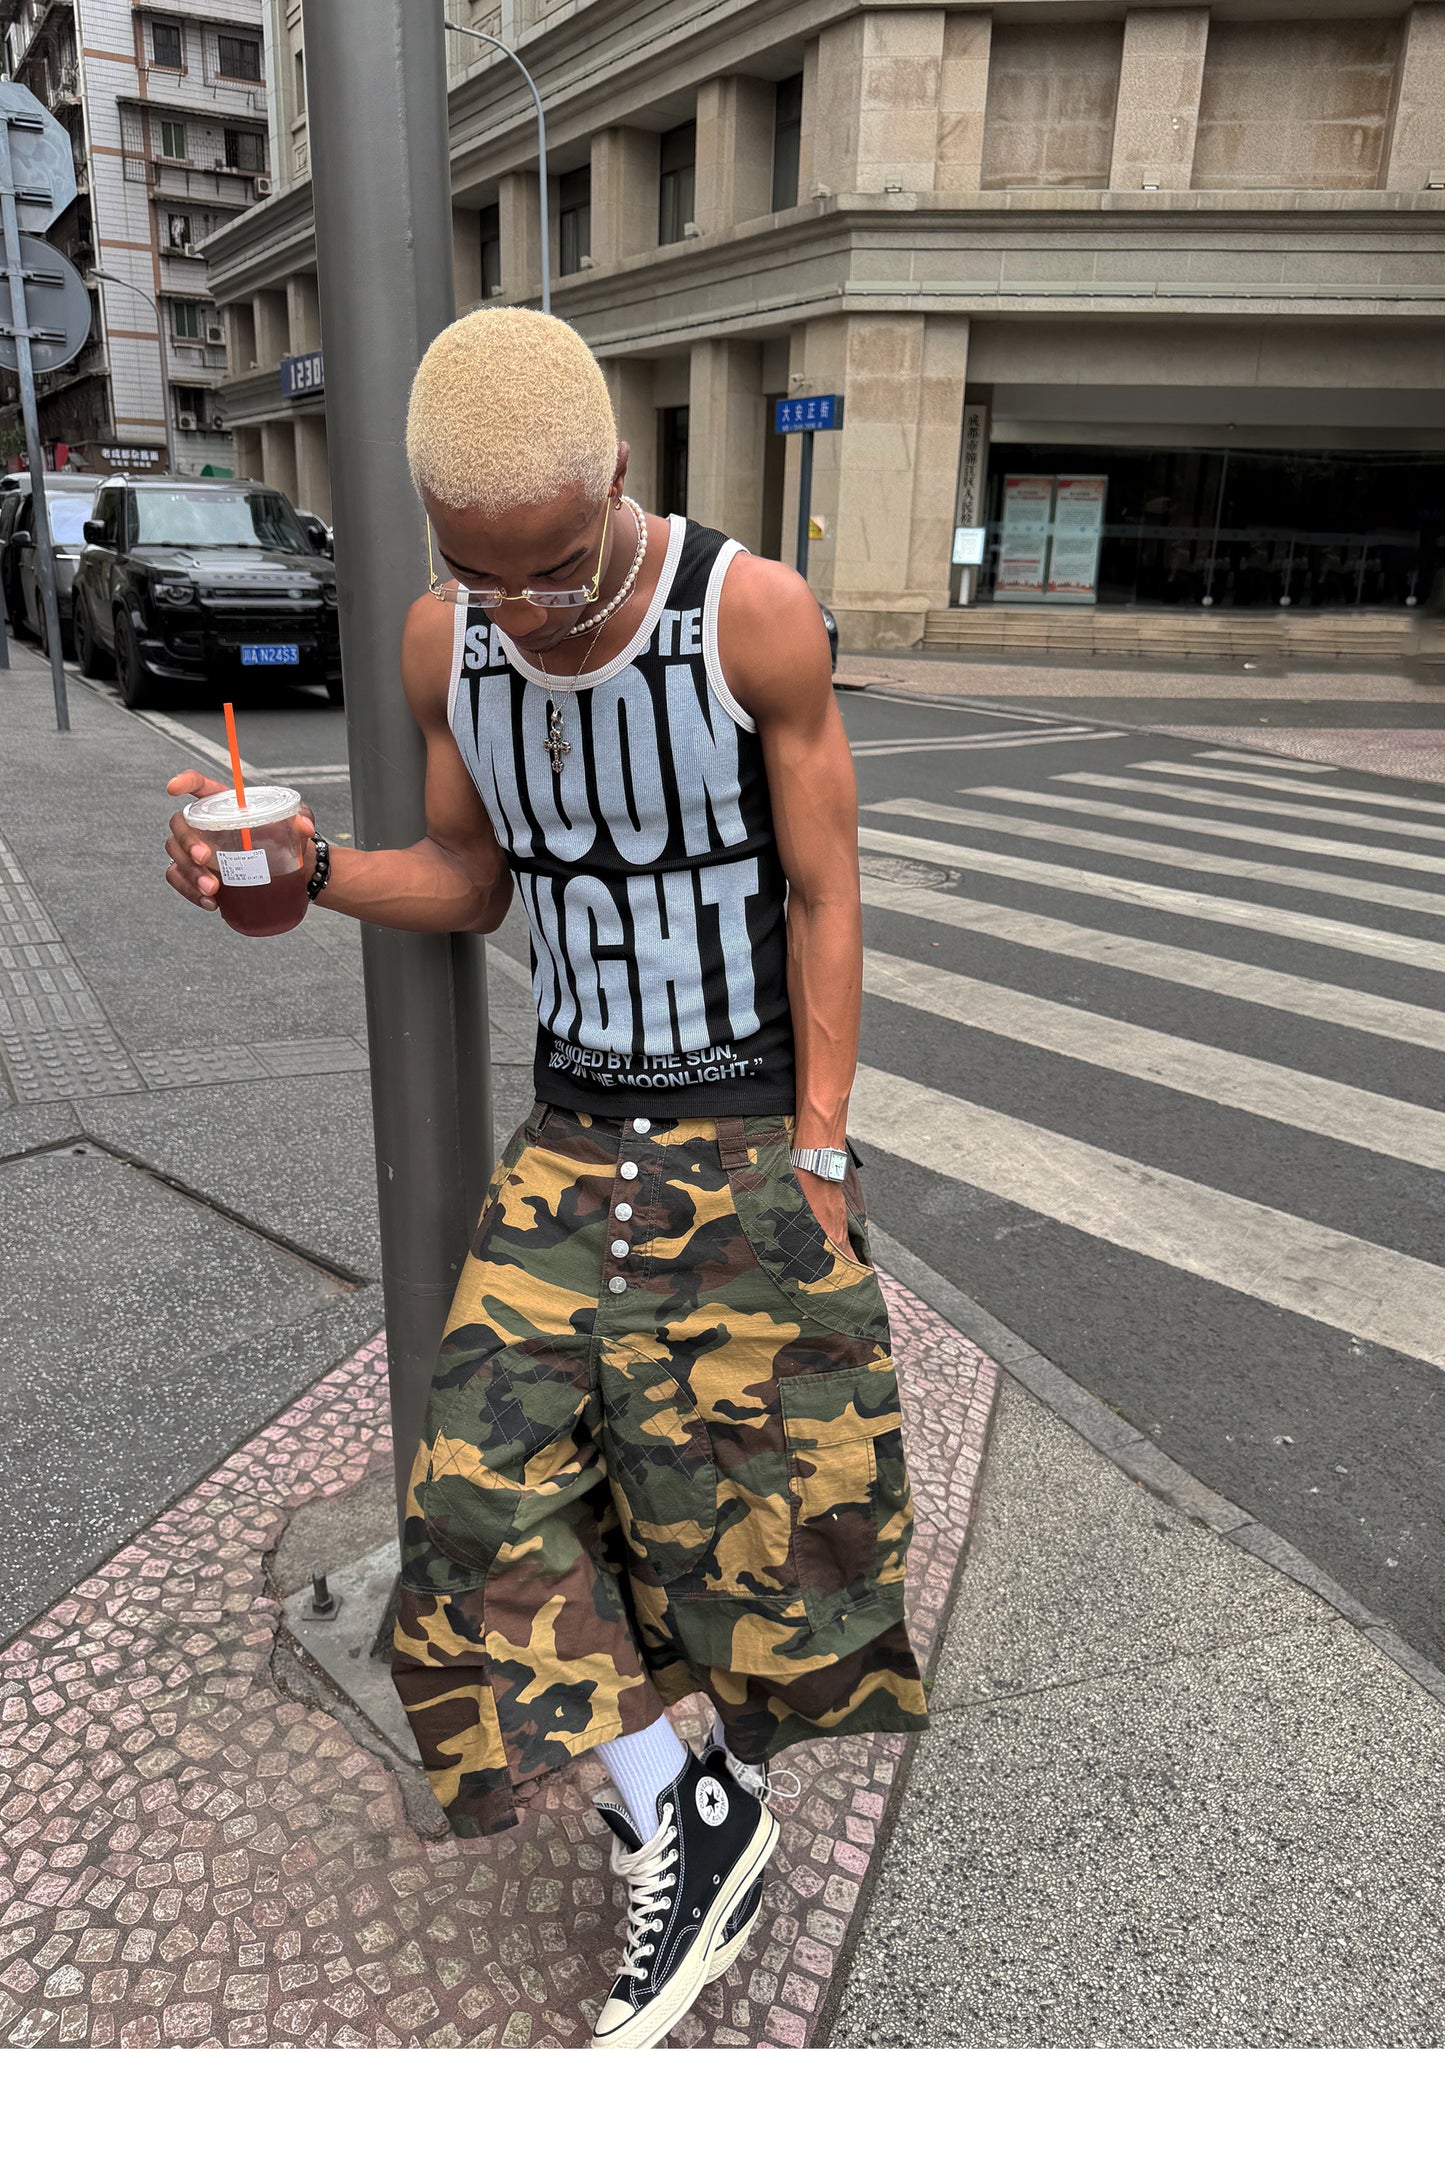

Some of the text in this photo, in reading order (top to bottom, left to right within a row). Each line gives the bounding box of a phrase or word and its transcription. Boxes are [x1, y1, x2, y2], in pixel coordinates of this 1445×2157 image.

[291, 356, 324, 390] 1230
[782, 400, 830, 422] 大安正街
[452, 663, 749, 866] MOON
[511, 857, 762, 1057] NIGHT
[607, 1052, 633, 1070] BY
[638, 1053, 682, 1070] THE
[686, 1045, 738, 1067] SUN,
